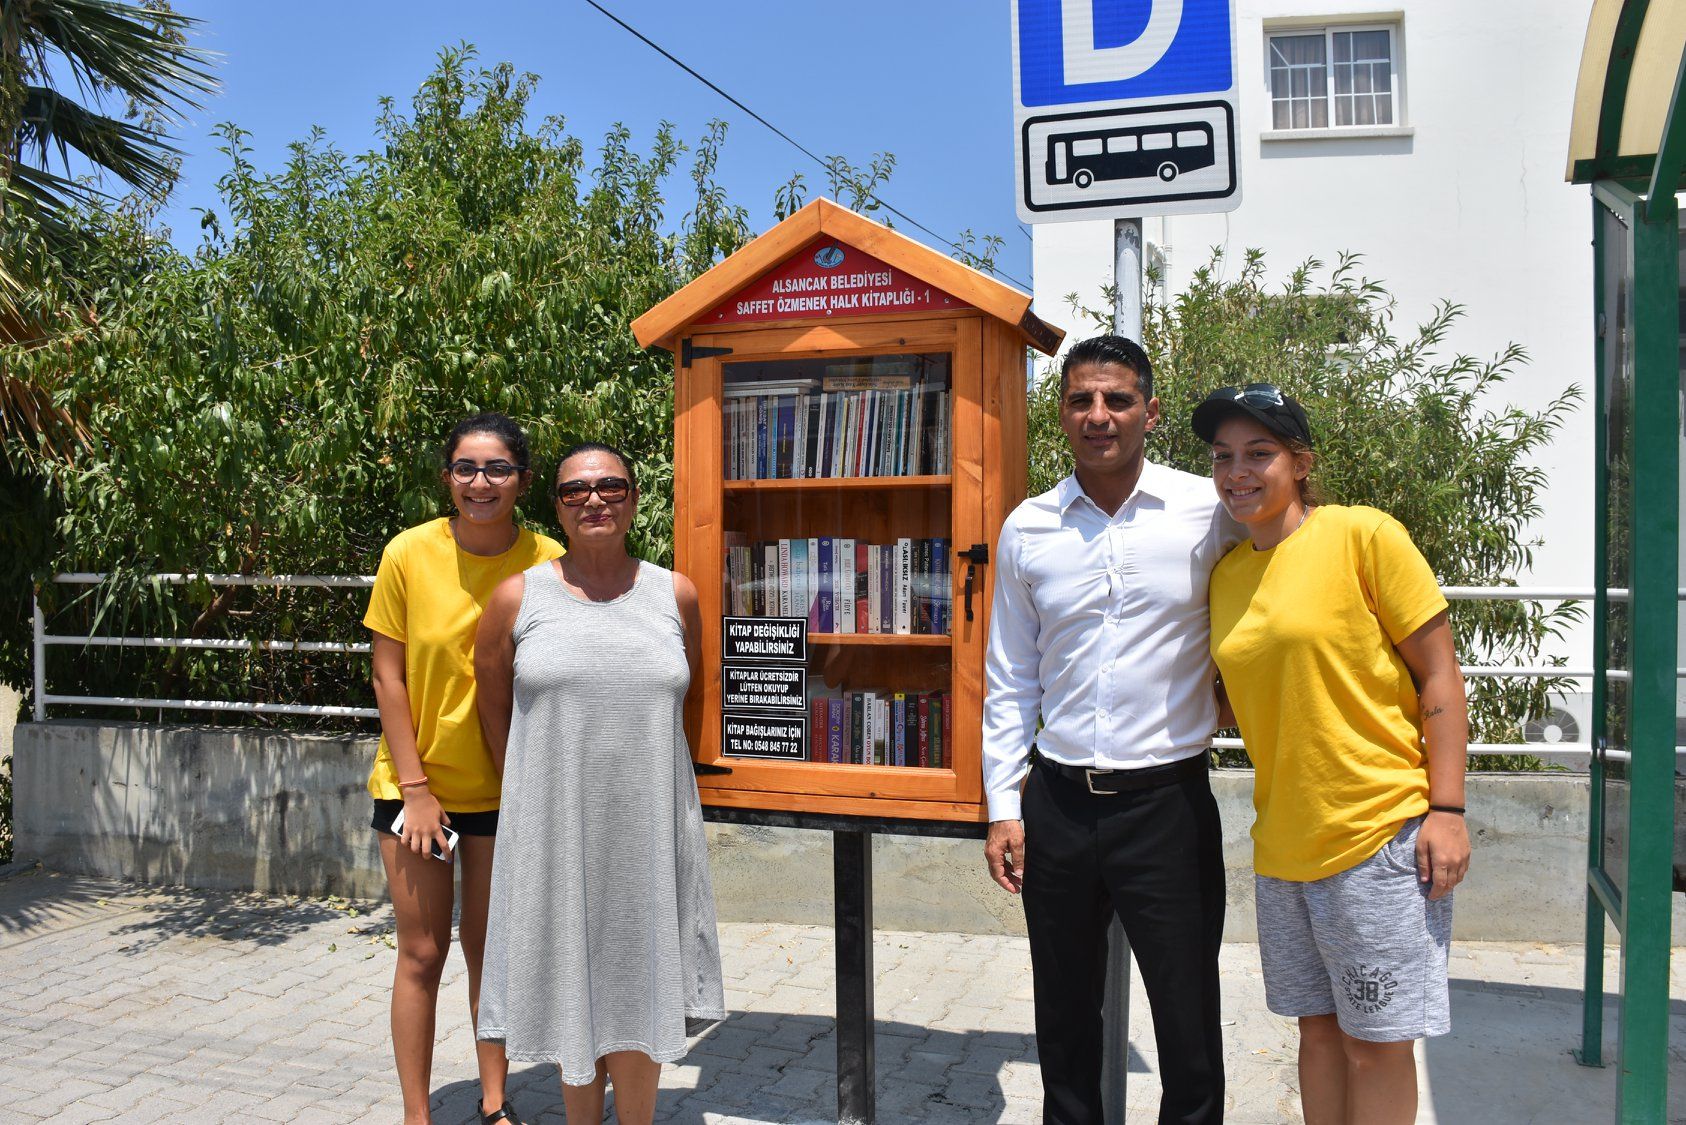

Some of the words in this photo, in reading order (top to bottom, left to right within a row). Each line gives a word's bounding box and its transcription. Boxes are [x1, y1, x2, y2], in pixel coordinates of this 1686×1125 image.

[772, 276, 828, 293] ALSANCAK
[830, 269, 892, 289] BELEDİYESİ
[736, 299, 774, 315] SAFFET
[777, 294, 828, 313] ÖZMENEK
[830, 293, 859, 309] HALK
[861, 287, 915, 307] KİTAPLIĞI
[924, 289, 930, 303] 1
[781, 562, 789, 588] HOWARD
[729, 622, 752, 637] KİTAP
[753, 623, 800, 640] DEĞİŞİKLİĞİ
[735, 639, 794, 654] YAPABİLİRSİNİZ
[730, 669, 759, 681] KİTAPLAR
[760, 670, 799, 682] ÜCRETSİZDİR
[740, 682, 763, 692] LÜTFEN
[763, 683, 789, 693] OKUYUP
[726, 693, 748, 704] YERİNE
[749, 694, 803, 706] BIRAKABİLİRSİNİZ
[727, 722, 745, 735] KİTAP
[745, 723, 788, 738] BAĞIŞLARINIZ
[788, 725, 801, 740] İÇİN
[730, 739, 742, 750] TEL
[742, 740, 754, 750] NO:
[754, 740, 769, 751] 0548
[769, 741, 780, 752] 845
[781, 742, 789, 752] 77
[790, 742, 798, 753] 22
[1342, 965, 1398, 990] CHICAGO
[1344, 986, 1362, 1011] STATE
[1364, 991, 1395, 1013] LEAGUE
[1354, 980, 1379, 1002] 38
